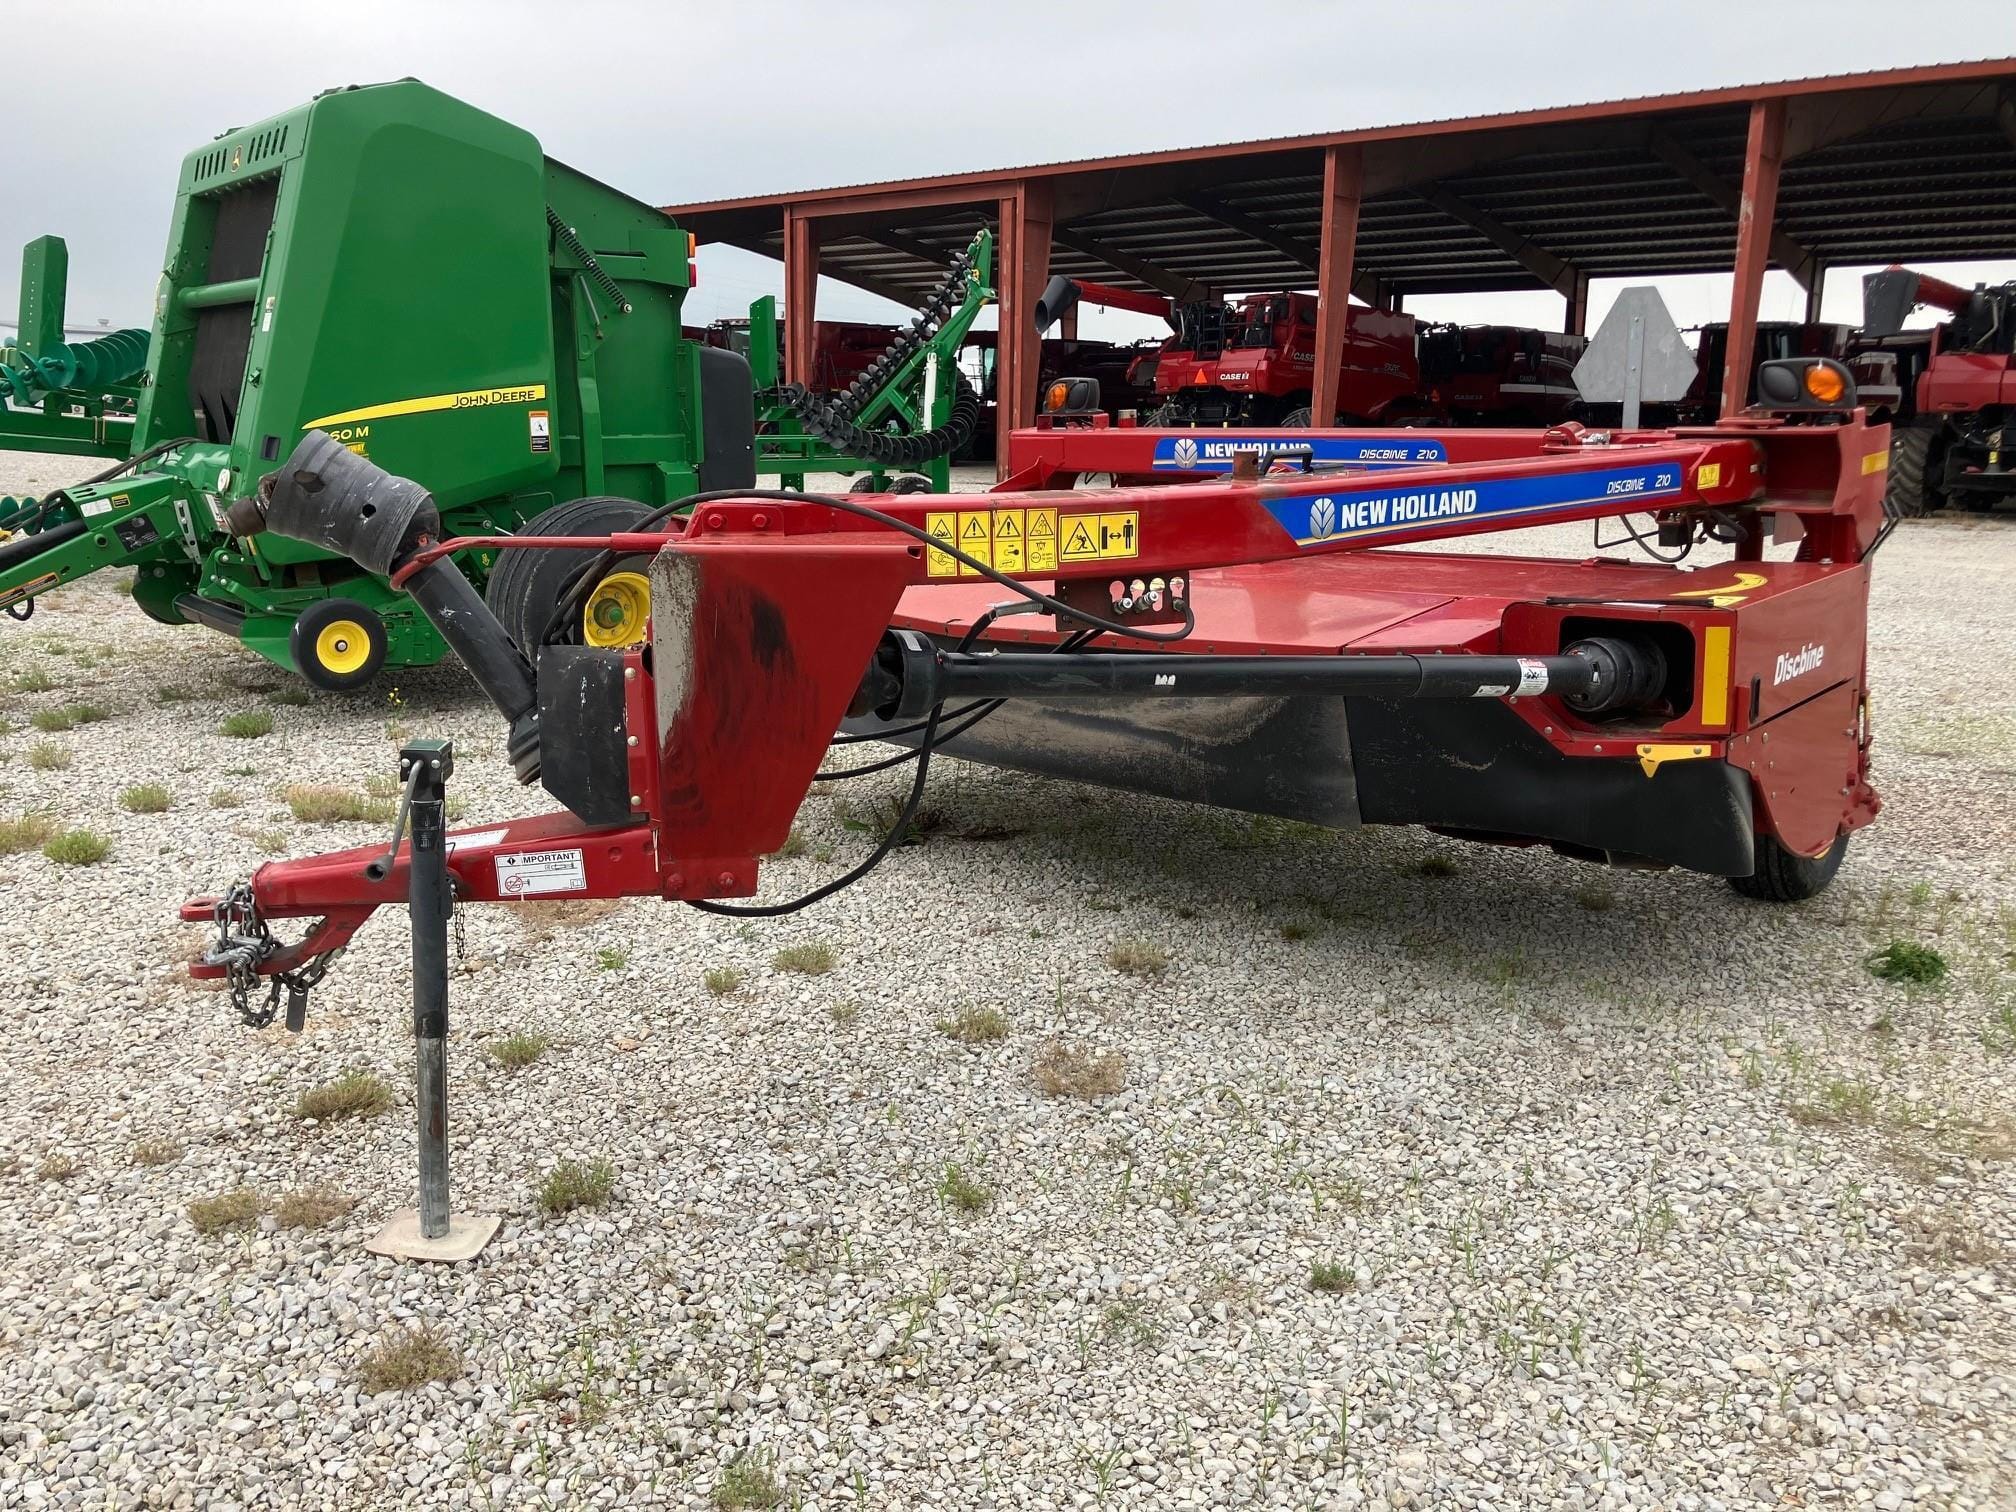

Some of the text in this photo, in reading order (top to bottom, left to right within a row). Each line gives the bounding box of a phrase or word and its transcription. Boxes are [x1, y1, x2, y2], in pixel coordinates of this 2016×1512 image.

[452, 390, 535, 407] JOHN DEERE
[327, 426, 369, 440] 60 M
[1205, 443, 1239, 457] NEW
[1359, 449, 1438, 459] DISCBINE 210
[1607, 474, 1671, 494] DISCBINE 210
[1341, 490, 1476, 529] NEW HOLLAND
[1774, 643, 1824, 686] Discbine
[522, 852, 575, 864] MPORTANT
